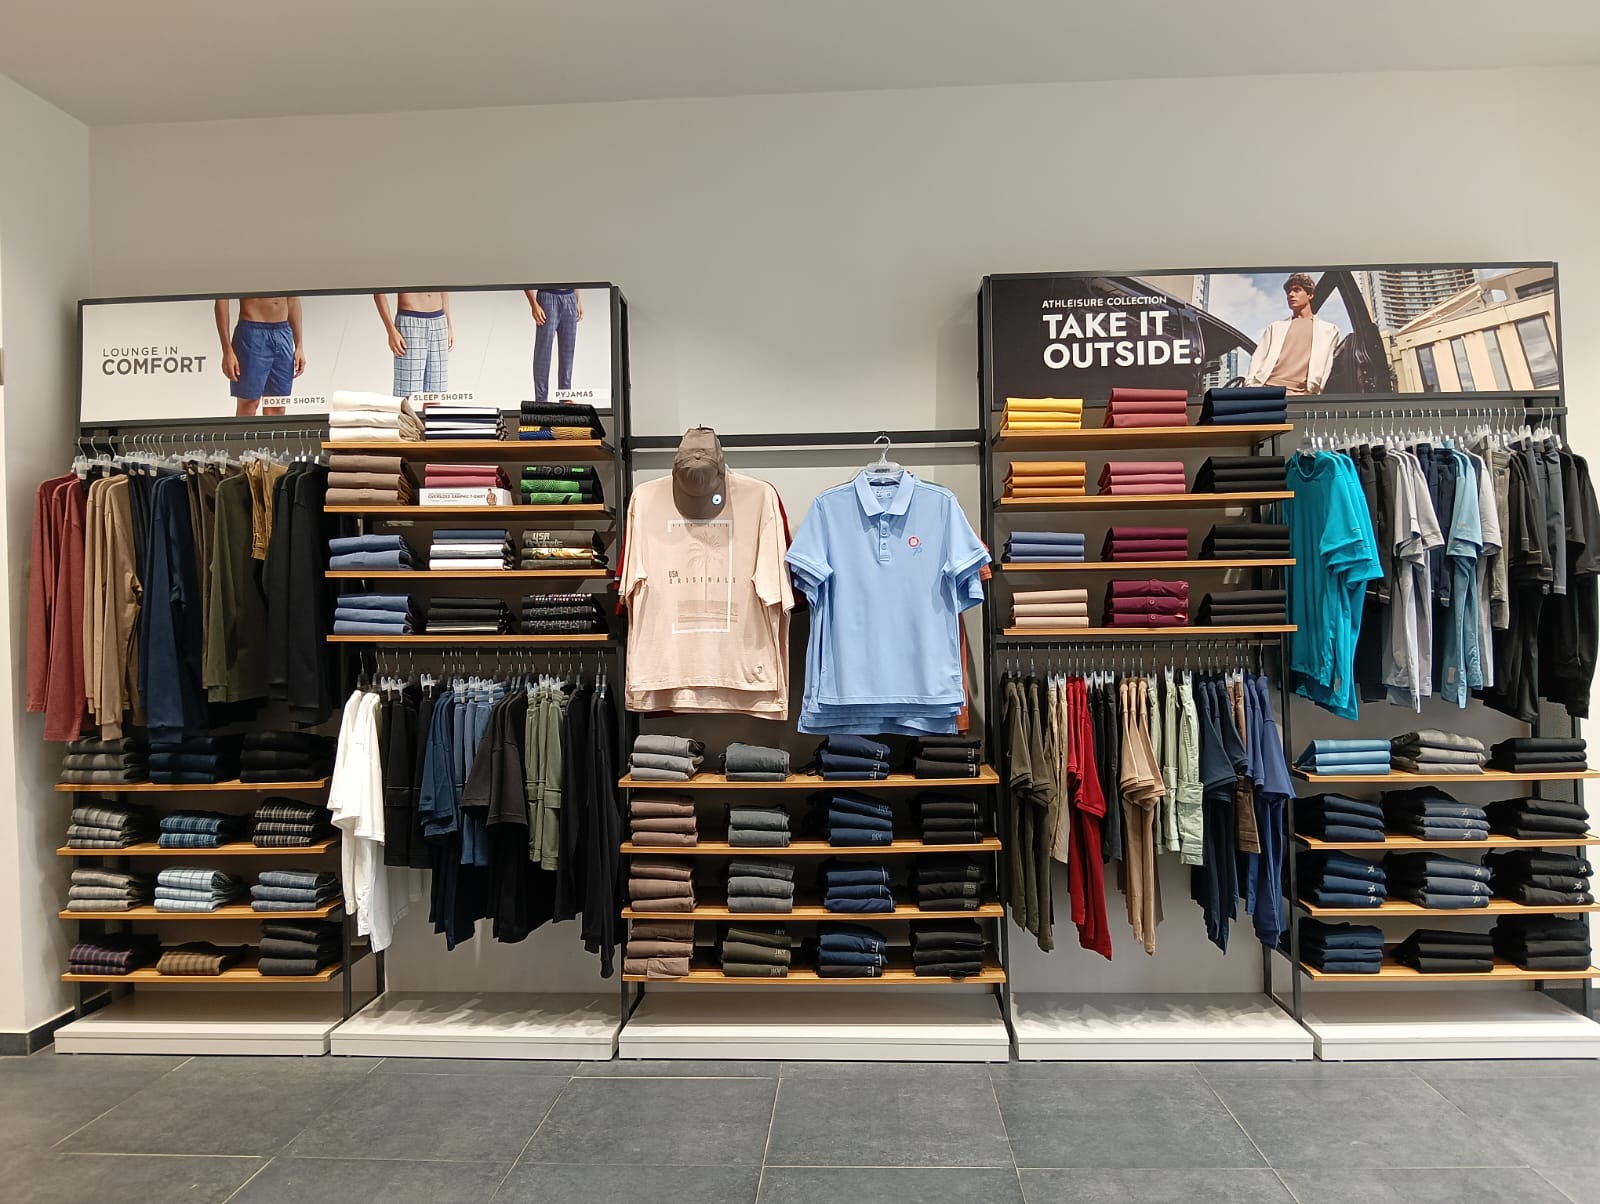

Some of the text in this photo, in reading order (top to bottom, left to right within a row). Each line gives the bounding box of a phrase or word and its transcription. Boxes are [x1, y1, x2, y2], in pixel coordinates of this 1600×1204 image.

[1041, 295, 1167, 309] ATHLEISURE COLLECTION
[1042, 310, 1169, 339] TAKE IT
[103, 345, 178, 357] LOUNGE IN
[1043, 339, 1202, 369] OUTSIDE.
[102, 356, 206, 375] COMFORT
[669, 570, 679, 578] USA
